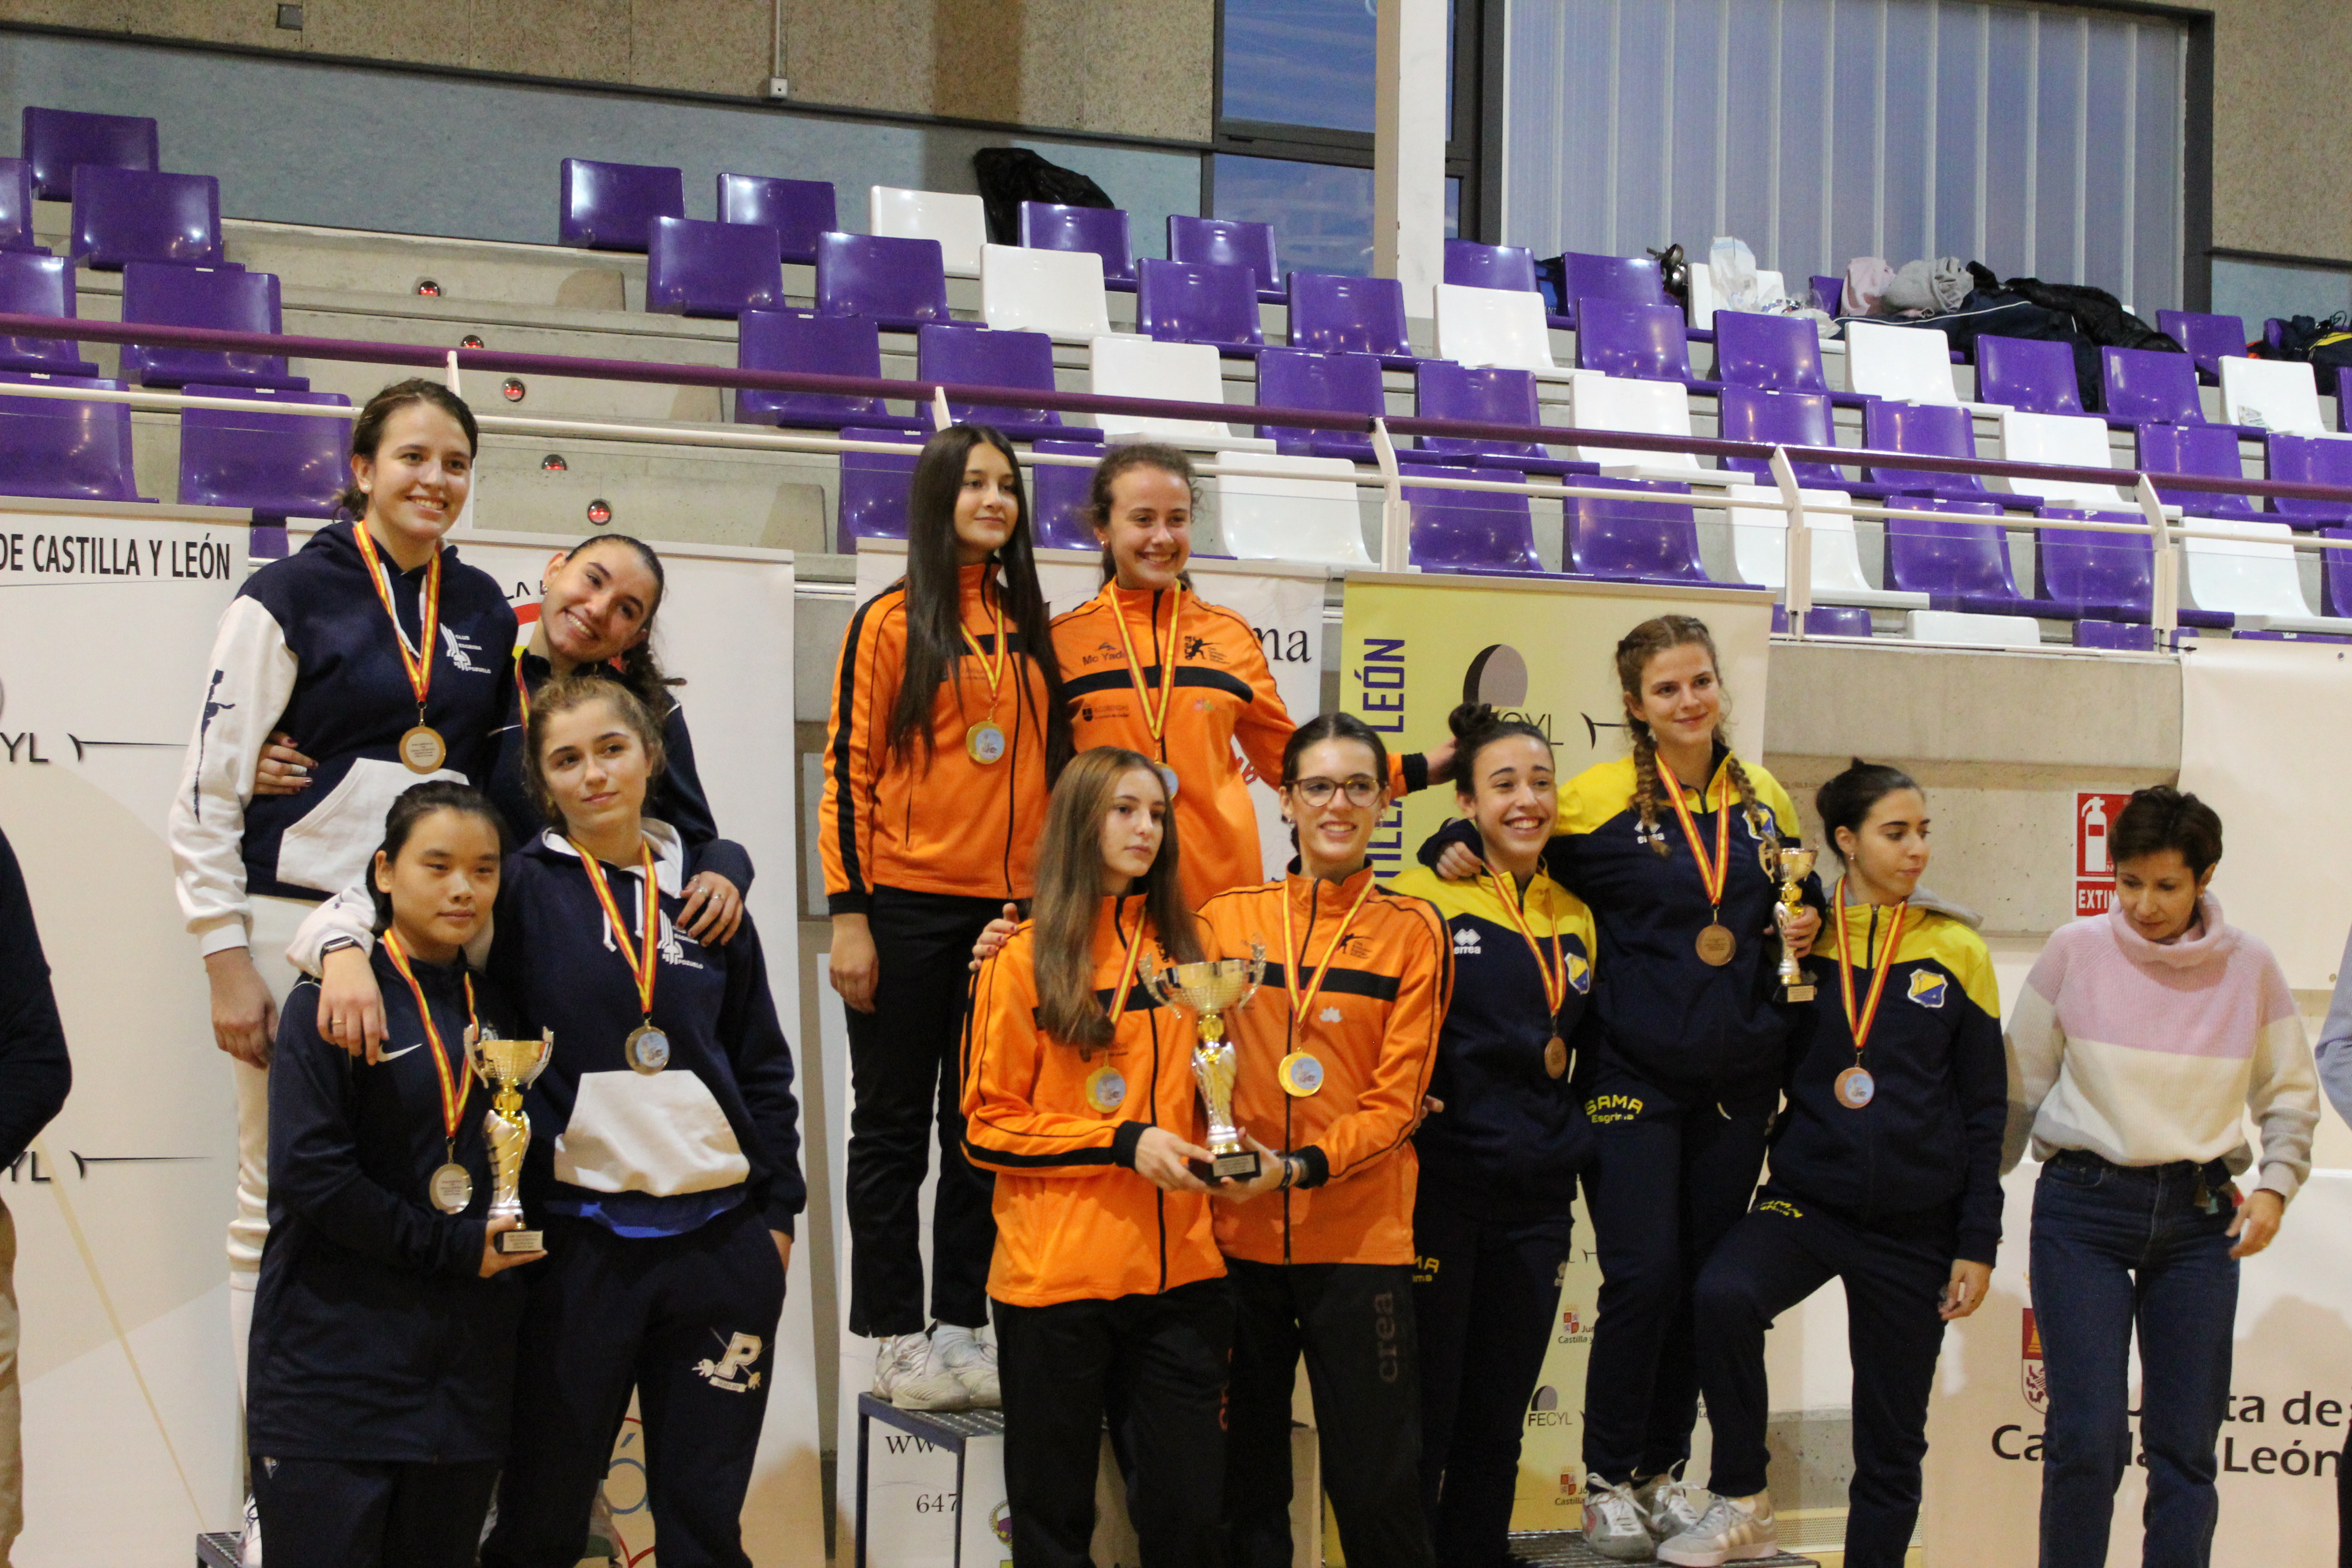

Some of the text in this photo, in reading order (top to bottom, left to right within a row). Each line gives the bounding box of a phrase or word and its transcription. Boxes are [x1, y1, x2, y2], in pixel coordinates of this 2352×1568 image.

[33, 535, 140, 576] CASTILLA
[149, 540, 163, 576] Y
[172, 533, 230, 580] LEÓN
[1354, 638, 1405, 733] LEÓN
[1585, 1094, 1644, 1116] SAMA
[1528, 1412, 1573, 1426] FECYL
[2283, 1391, 2343, 1427] de
[2223, 1440, 2342, 1477] León
